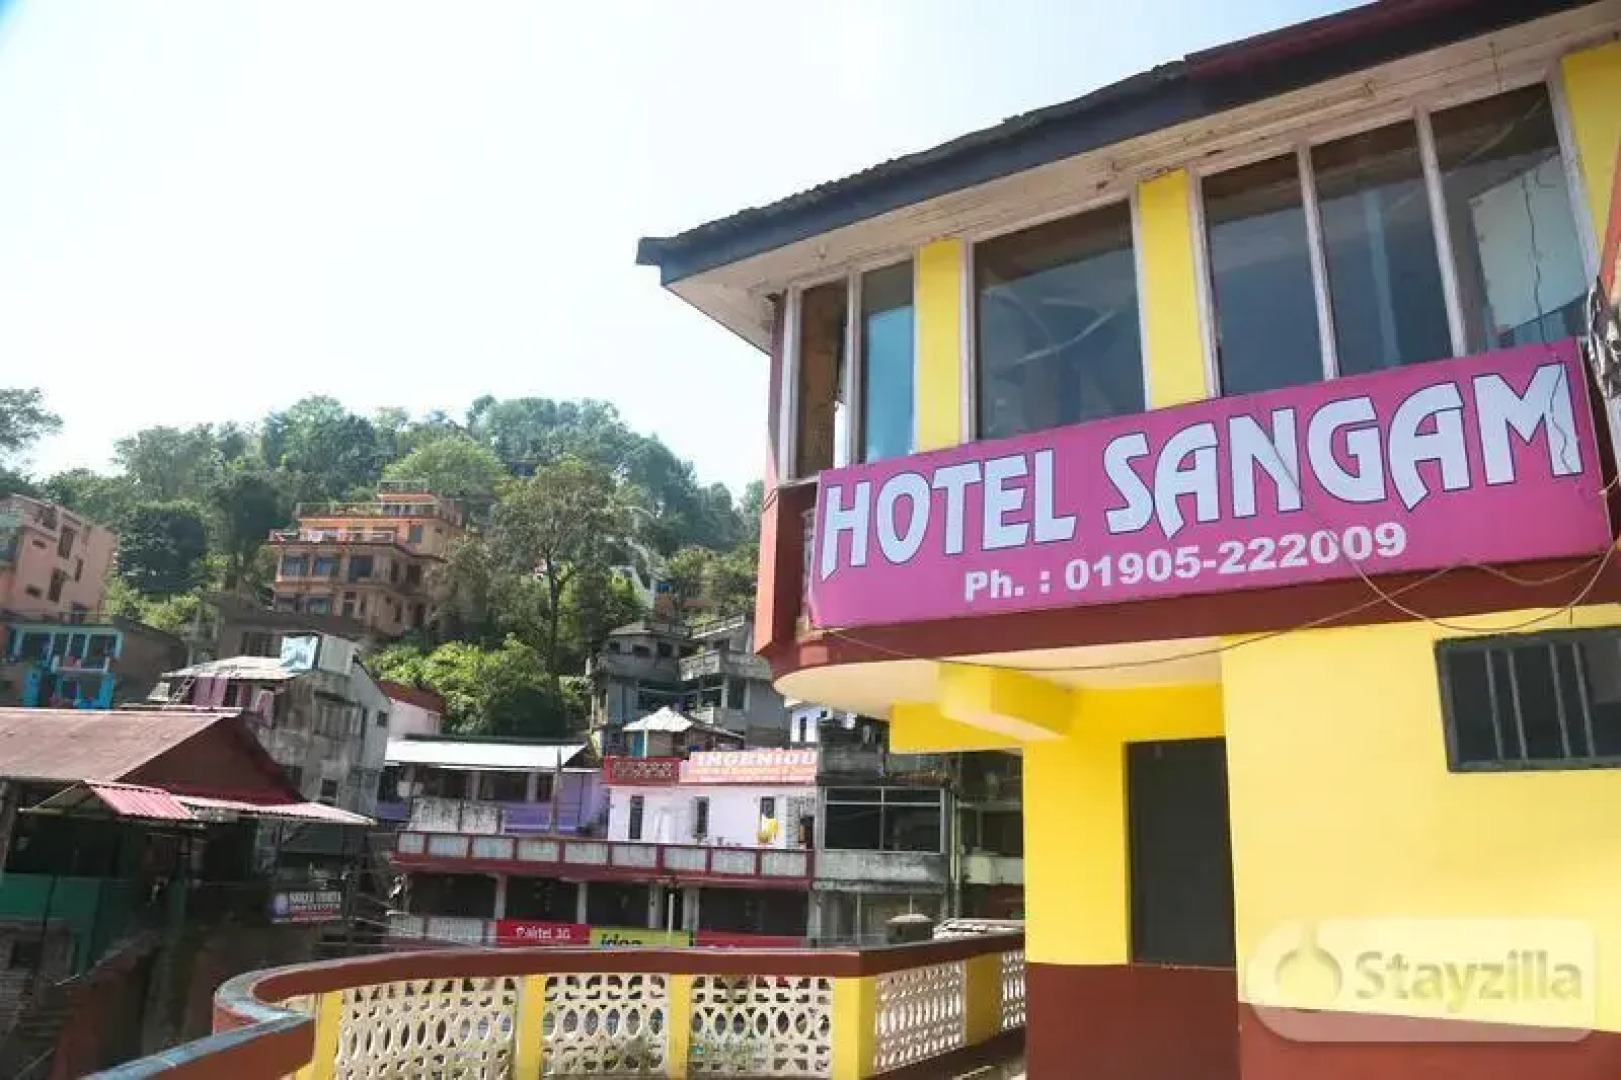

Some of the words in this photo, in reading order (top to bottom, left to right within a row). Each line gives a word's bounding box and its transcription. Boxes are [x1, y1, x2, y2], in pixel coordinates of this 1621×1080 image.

[819, 448, 1077, 582] HOTEL
[1104, 362, 1584, 539] SANGAM
[964, 569, 1025, 603] Ph.
[1065, 521, 1408, 593] 01905-222009
